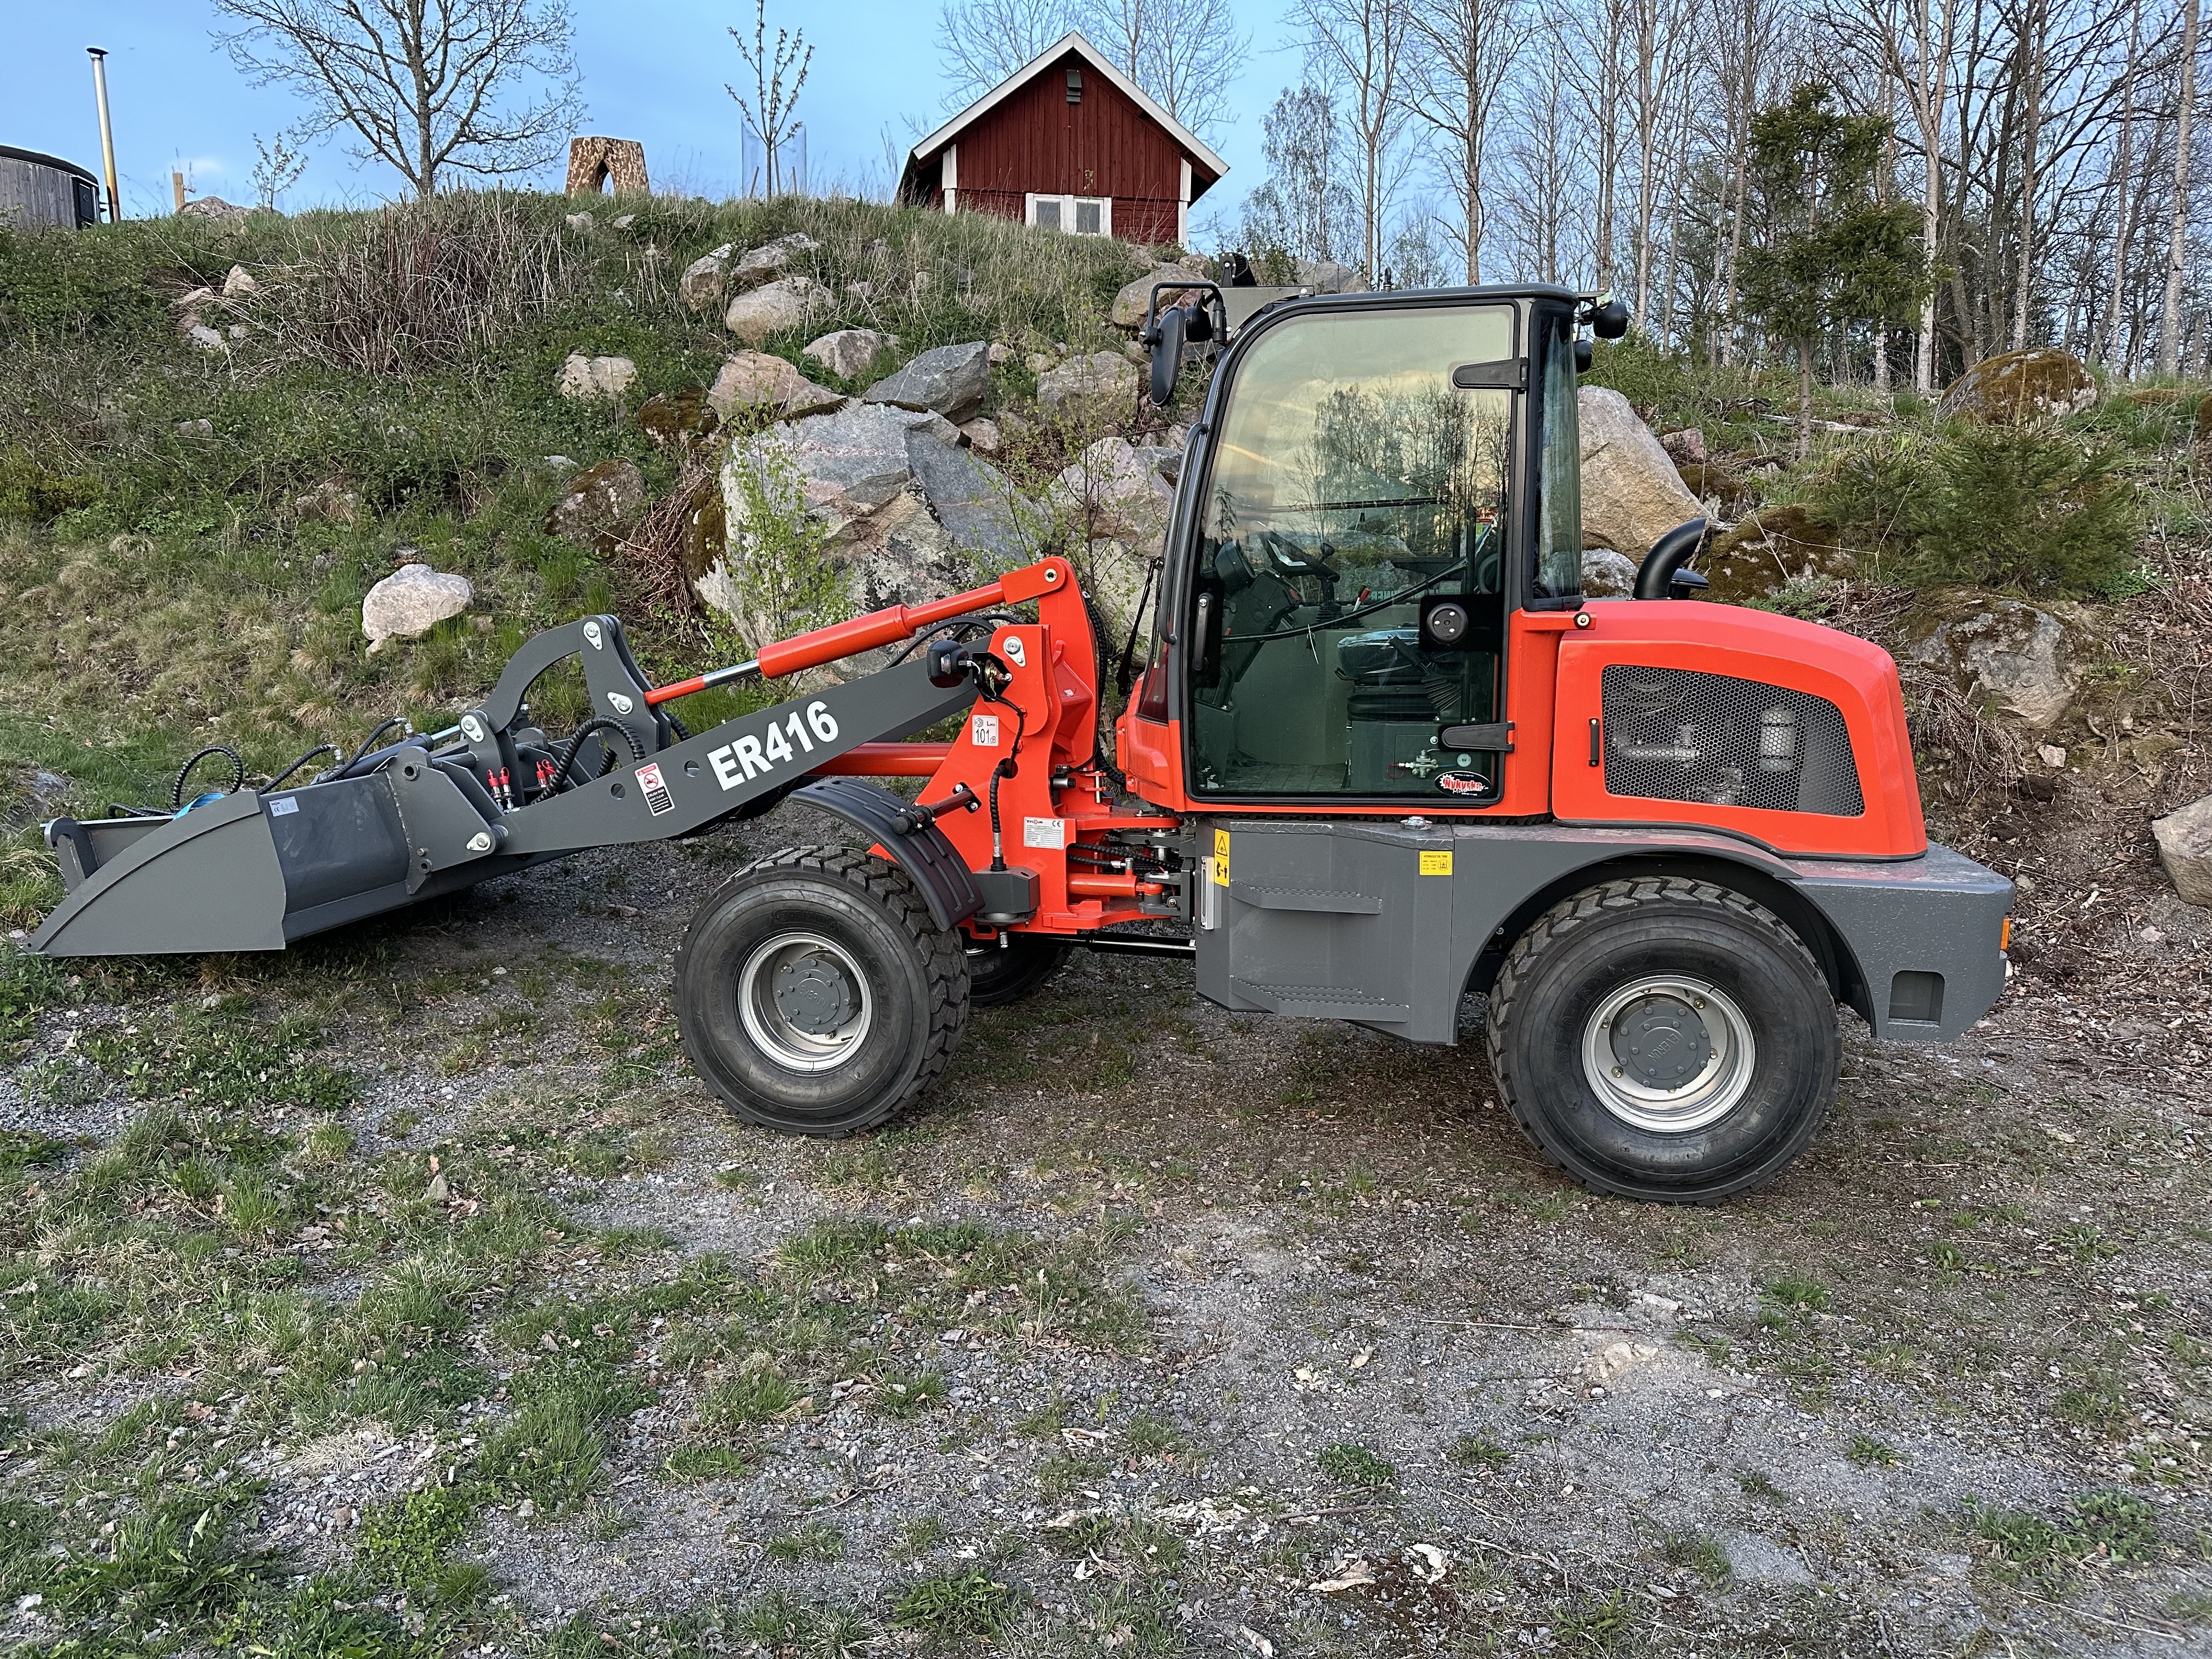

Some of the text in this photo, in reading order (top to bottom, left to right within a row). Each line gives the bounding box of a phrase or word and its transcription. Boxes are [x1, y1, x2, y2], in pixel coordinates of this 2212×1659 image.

[707, 700, 839, 791] ER416
[975, 728, 990, 743] 101
[1443, 778, 1482, 792] Nykyrka
[799, 985, 827, 1007] EVERUN
[1647, 1033, 1681, 1062] EVERUN
